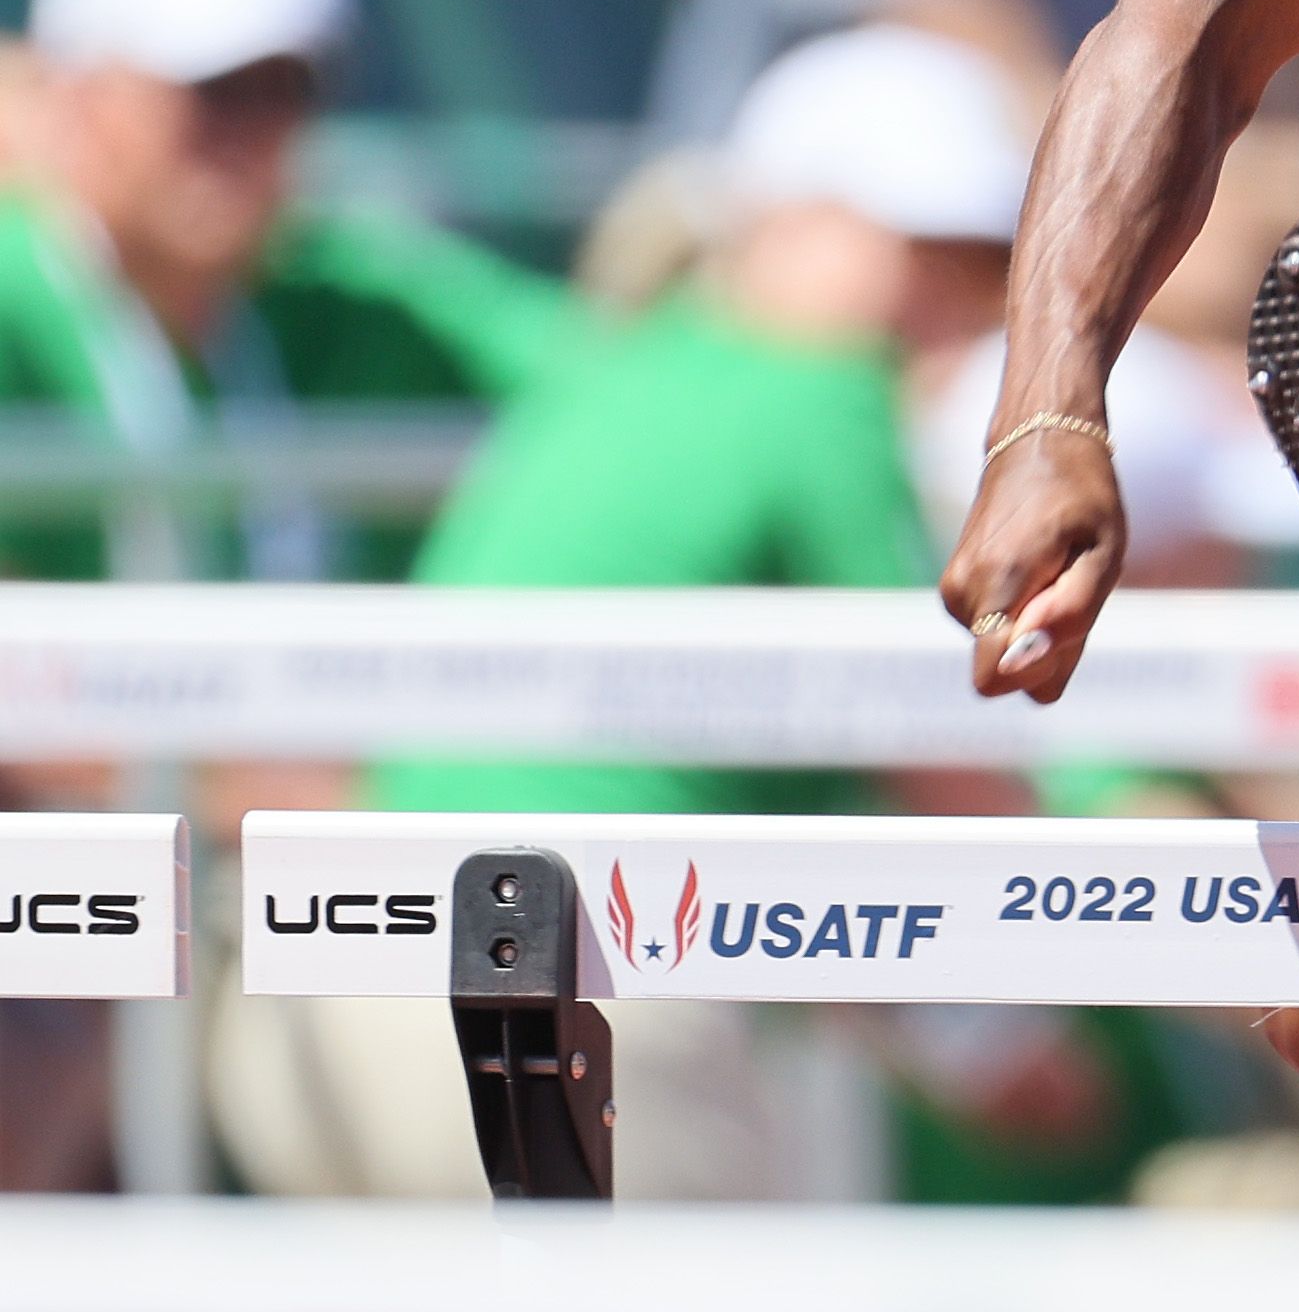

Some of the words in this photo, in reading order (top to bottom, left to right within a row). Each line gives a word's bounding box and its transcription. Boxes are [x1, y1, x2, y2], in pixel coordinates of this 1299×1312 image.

[265, 894, 437, 935] UCS
[1000, 876, 1156, 921] 2022
[710, 903, 944, 958] USATF
